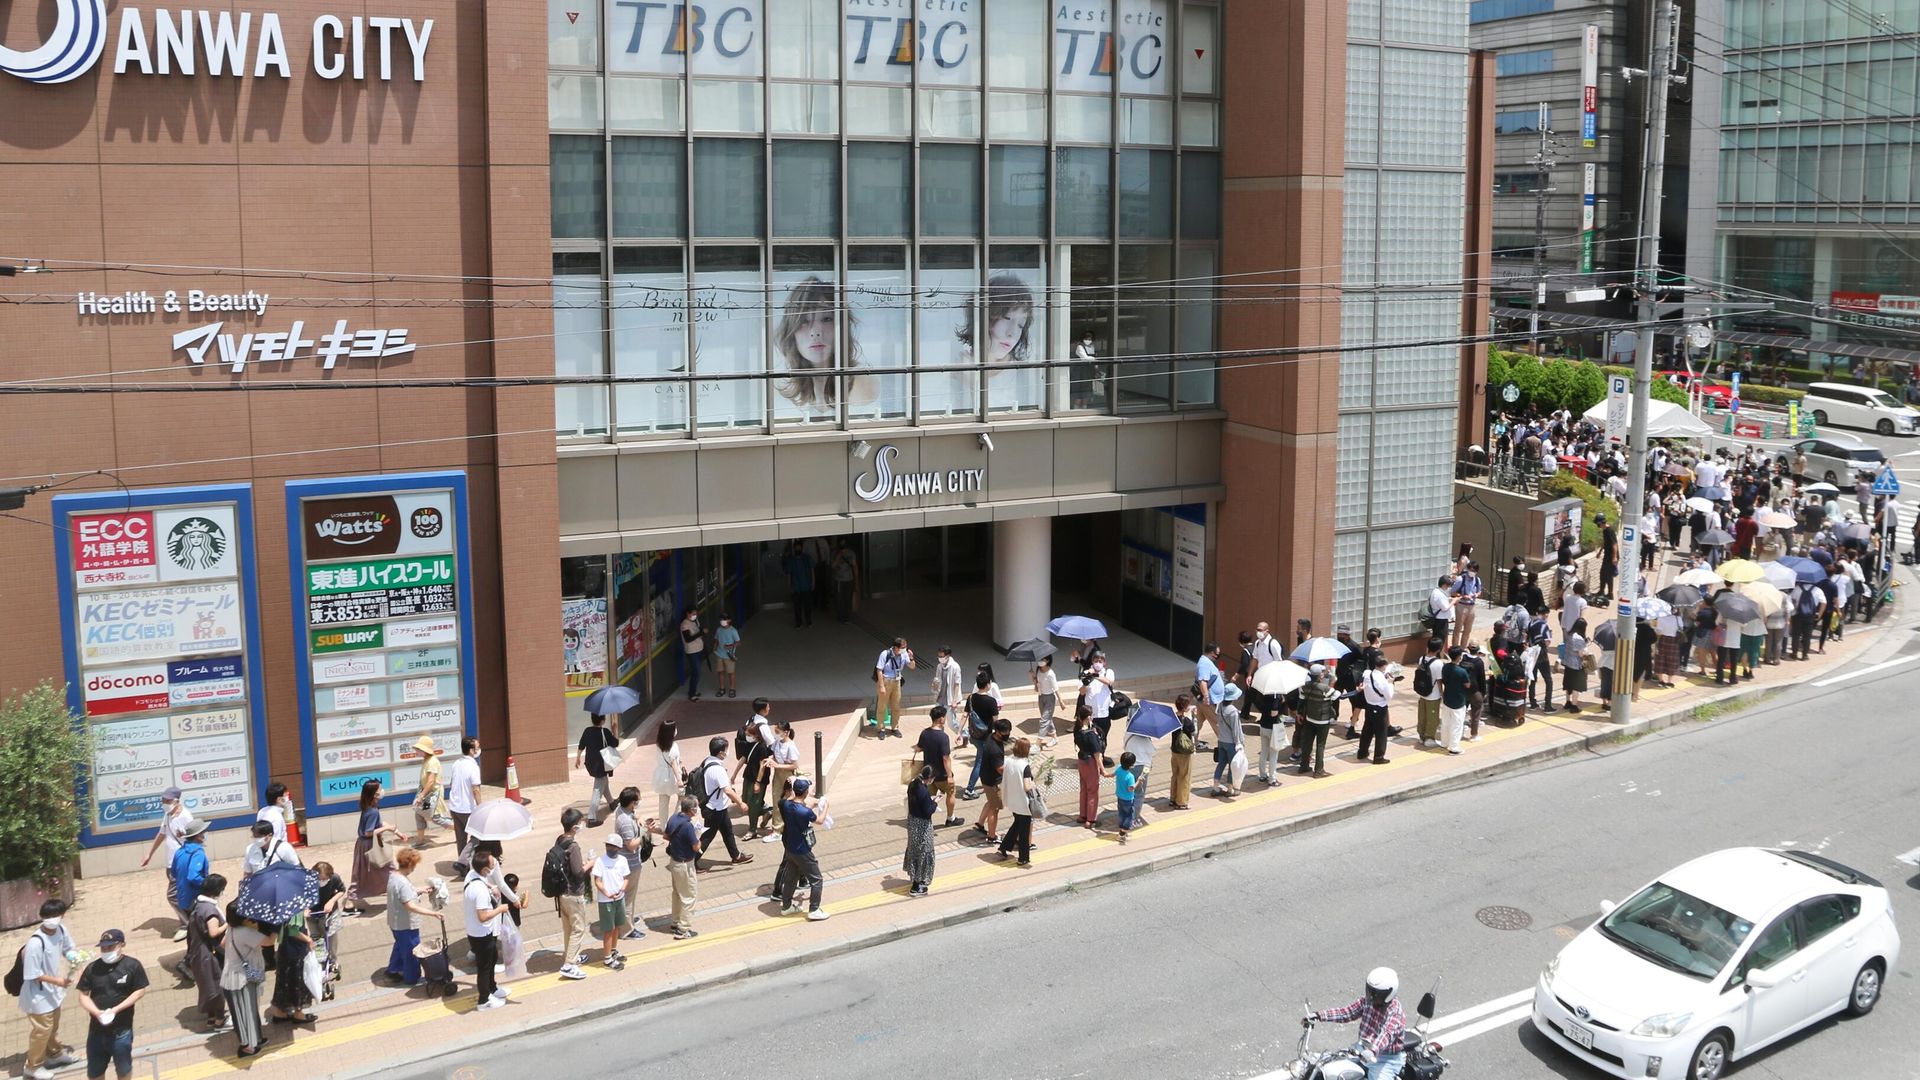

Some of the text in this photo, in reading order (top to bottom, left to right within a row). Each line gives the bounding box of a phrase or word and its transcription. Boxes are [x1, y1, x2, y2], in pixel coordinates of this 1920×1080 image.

[616, 1, 753, 58] TBC
[312, 14, 434, 81] CITY
[846, 15, 968, 69] TBC
[1056, 28, 1162, 80] TBC
[78, 289, 269, 316] Health & Beauty
[173, 320, 417, 373] マツモトキヨシ
[654, 384, 721, 394] CARNA
[948, 469, 984, 493] CITY
[315, 518, 384, 538] Watts
[414, 514, 439, 526] 100
[80, 517, 147, 542] ECC
[82, 540, 149, 558] 外語学院
[84, 572, 126, 583] 西大寺校
[310, 560, 450, 590] 東進ハイスクール
[83, 594, 235, 623] KECゼミナール
[86, 622, 175, 645] KEC個別
[315, 630, 378, 648] SUBWAY
[174, 665, 209, 677] ブルーム
[407, 658, 452, 670] 三井住友銀行
[88, 674, 165, 691] docomo
[135, 697, 168, 705] ドコモショップ
[195, 713, 237, 725] かなもり
[395, 711, 420, 726] girls
[339, 746, 385, 762] ツキムラ
[198, 767, 241, 781] 飯田眼科
[201, 793, 243, 806] まりん薬局
